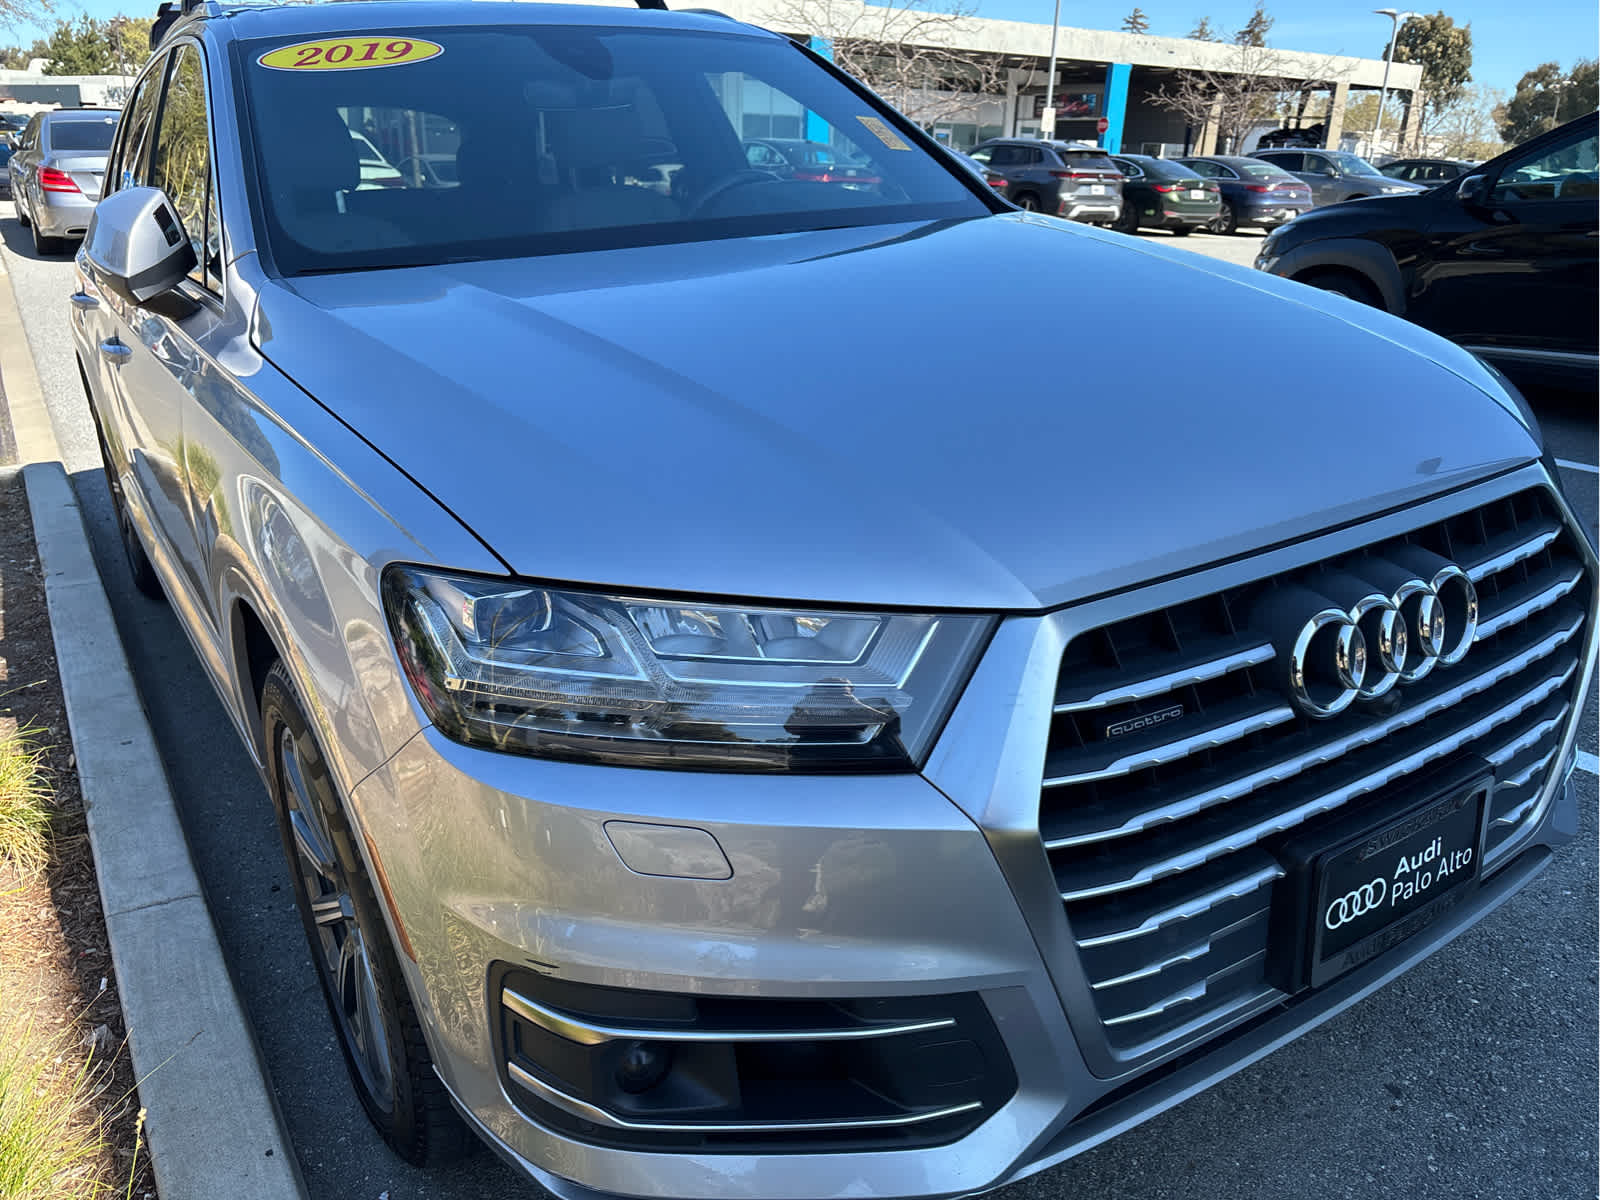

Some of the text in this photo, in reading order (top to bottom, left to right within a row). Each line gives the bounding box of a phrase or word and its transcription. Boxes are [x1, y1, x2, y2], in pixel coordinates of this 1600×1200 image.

[293, 41, 413, 67] 2019
[1110, 708, 1182, 736] quattro
[1394, 836, 1442, 879] Audi
[1392, 847, 1472, 907] Palo Alto
